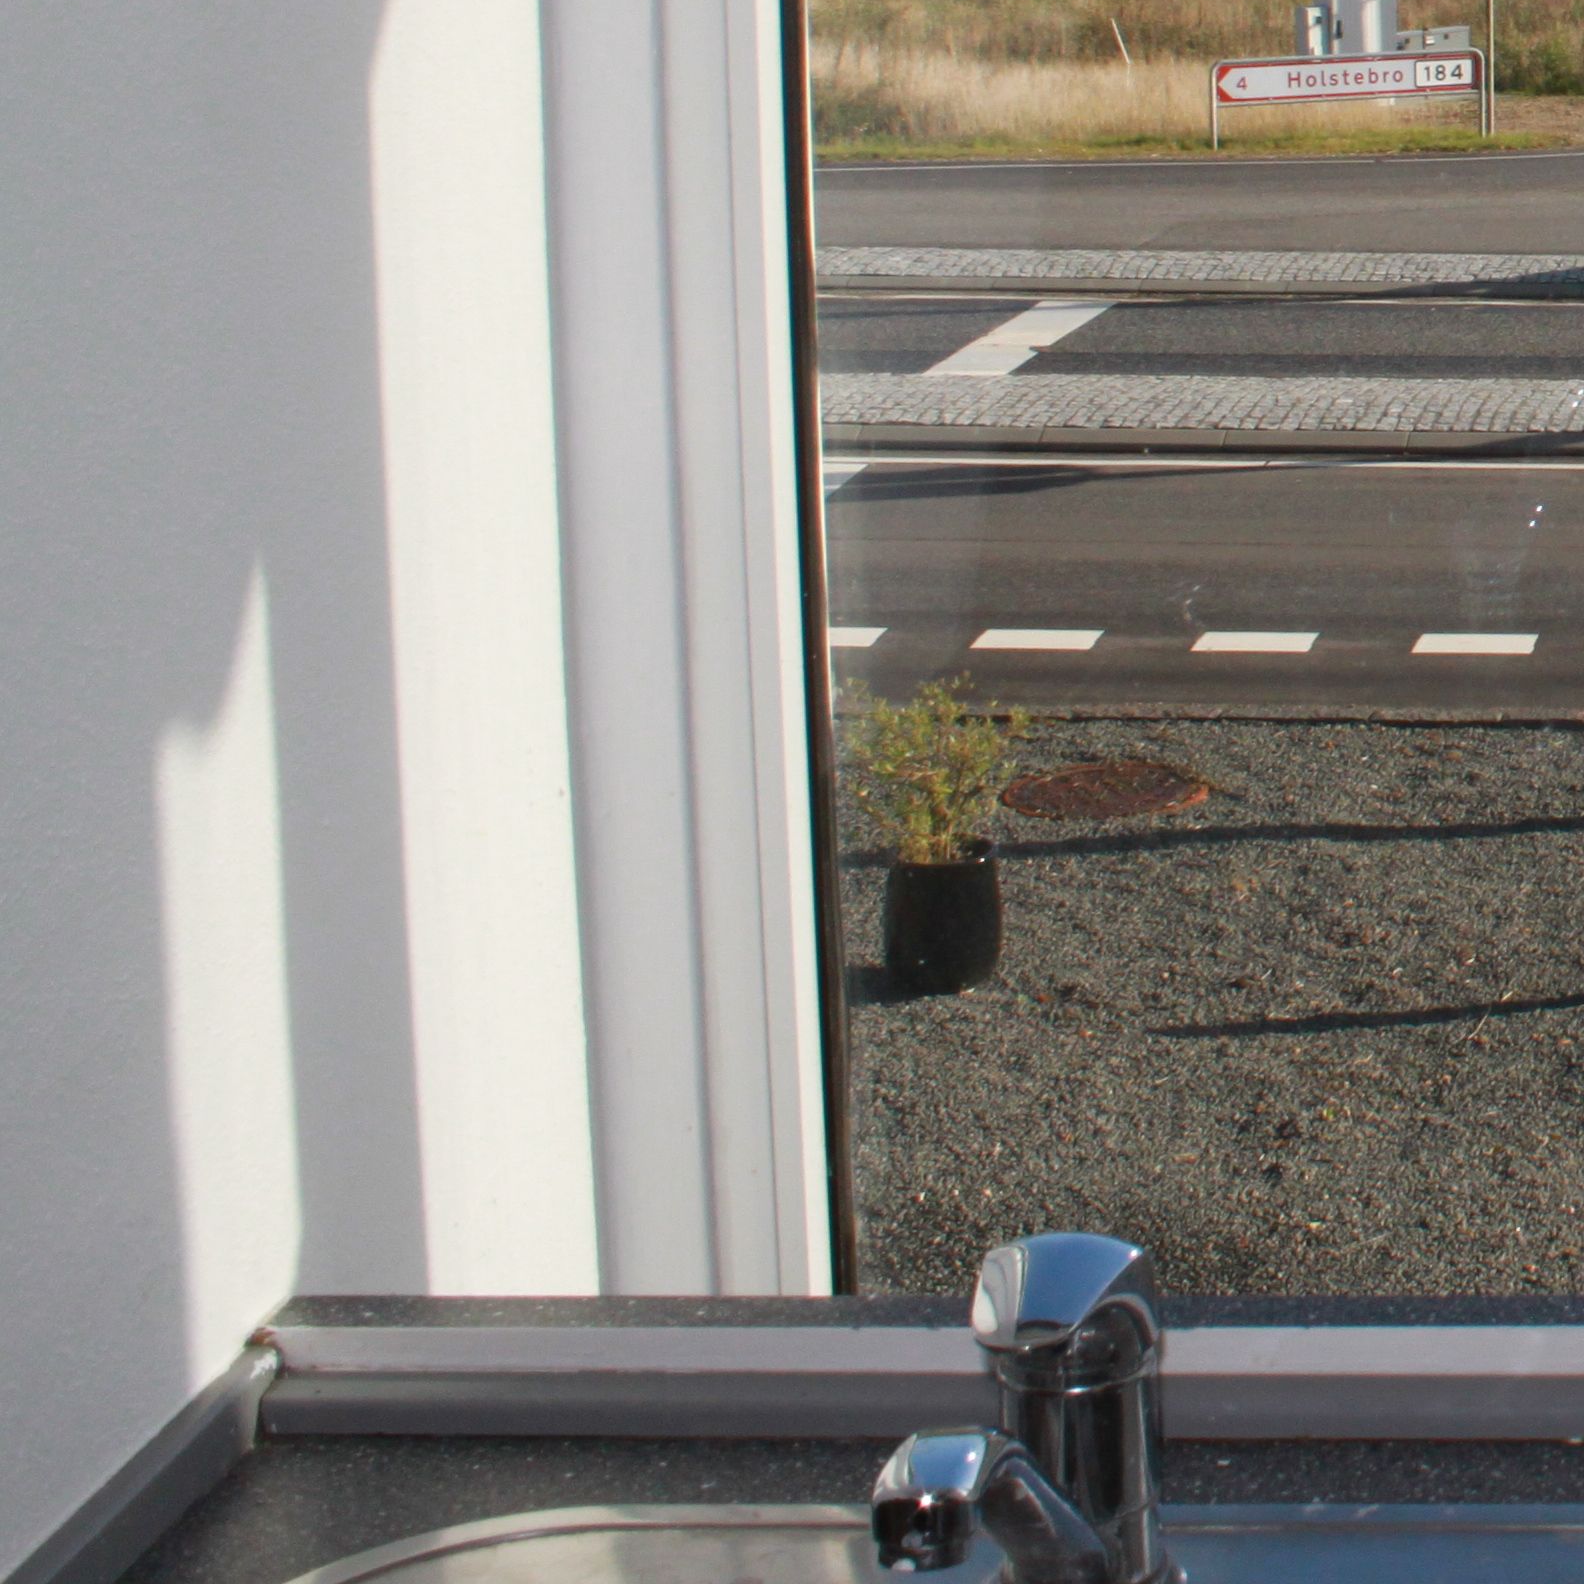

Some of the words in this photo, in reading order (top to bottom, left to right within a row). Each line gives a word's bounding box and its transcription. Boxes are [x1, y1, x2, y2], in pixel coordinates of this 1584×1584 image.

[1236, 75, 1248, 91] 4
[1287, 67, 1404, 89] Holstebro
[1423, 64, 1465, 82] 184
